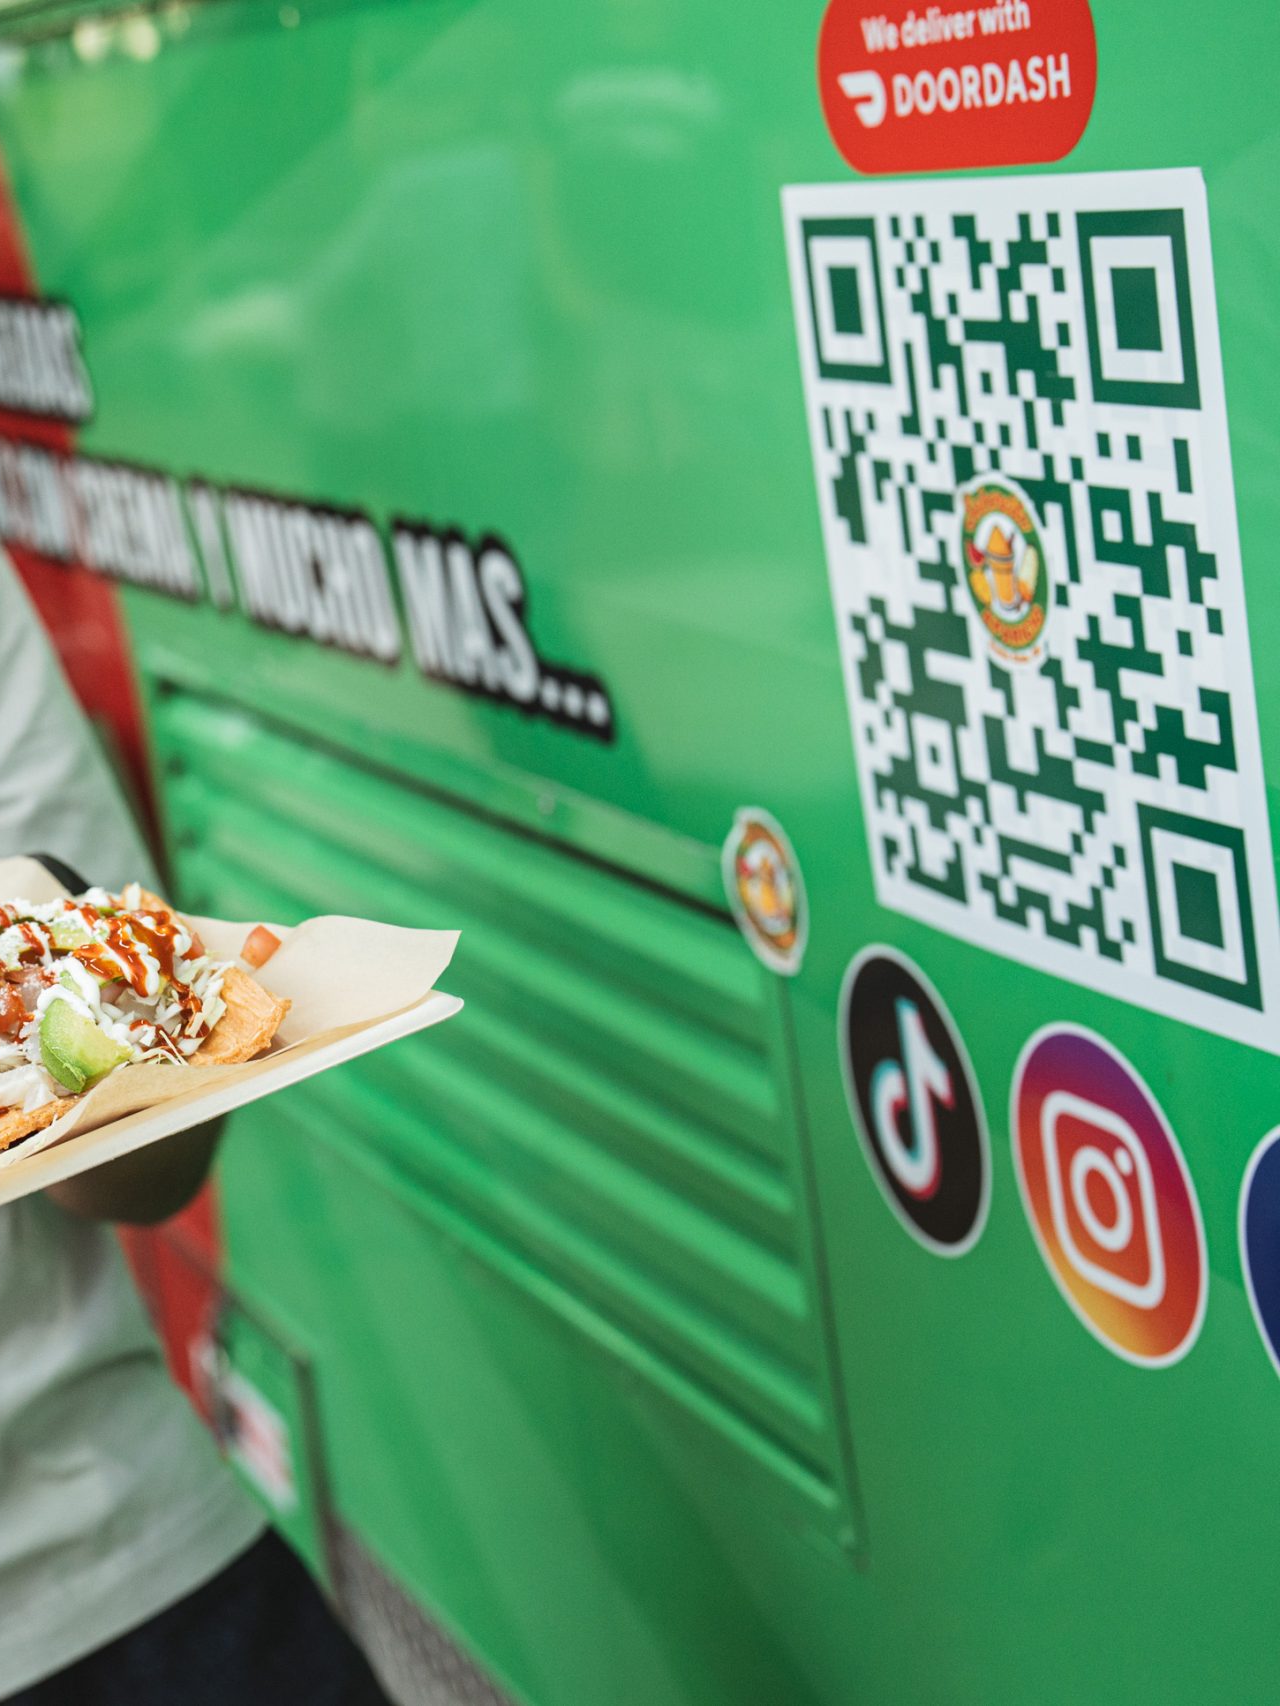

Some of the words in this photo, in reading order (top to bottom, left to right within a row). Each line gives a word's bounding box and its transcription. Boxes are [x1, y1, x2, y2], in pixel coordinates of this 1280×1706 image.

[860, 15, 899, 53] We
[901, 6, 976, 48] deliver
[977, 0, 1031, 36] with
[892, 52, 1071, 117] DOORDASH
[223, 490, 402, 664] MUCHO
